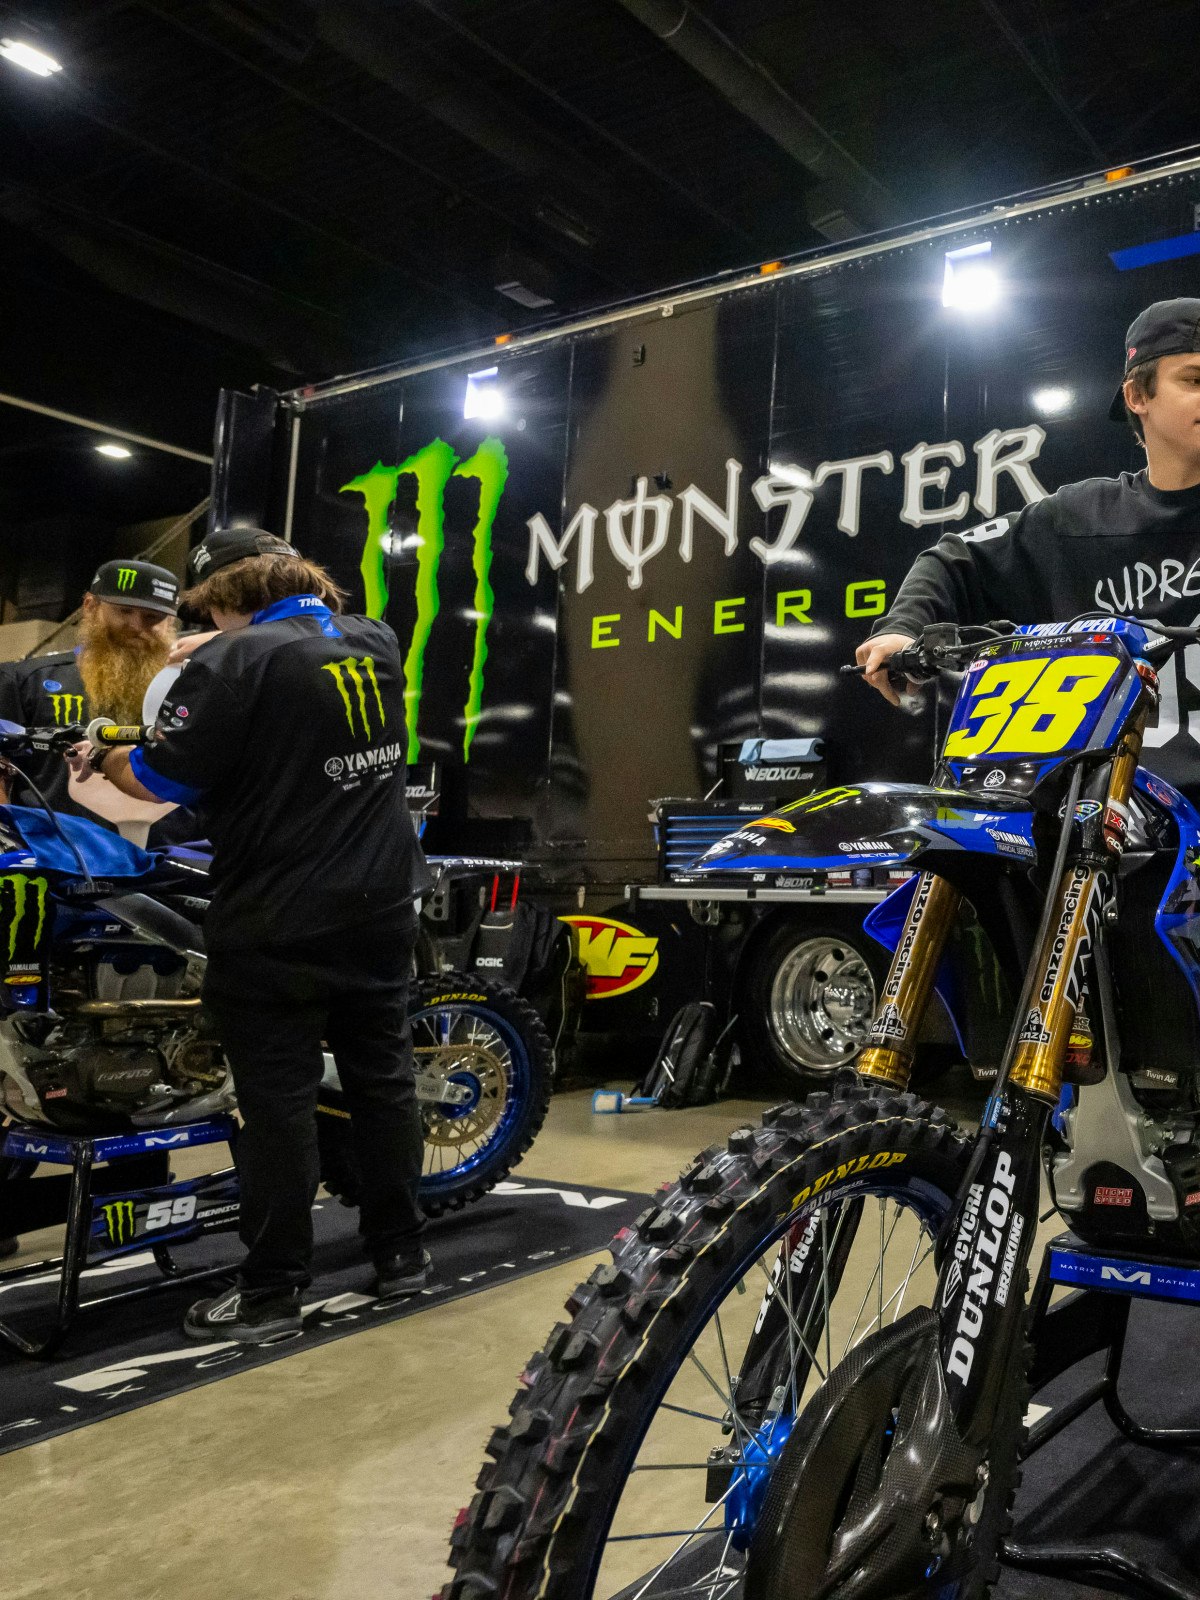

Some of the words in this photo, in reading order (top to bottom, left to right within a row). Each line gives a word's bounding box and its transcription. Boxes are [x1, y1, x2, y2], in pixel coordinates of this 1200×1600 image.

[525, 424, 1049, 593] MONSTER
[590, 580, 886, 650] ENERG
[1024, 636, 1073, 648] MONSTER
[943, 655, 1122, 758] 38
[344, 742, 401, 772] YAMAHA
[755, 766, 801, 781] BOXO
[850, 841, 894, 851] YAMAHA
[1000, 830, 1031, 847] YAMAHA
[462, 857, 523, 867] DUNLOP
[1040, 864, 1091, 1003] enzoracing
[578, 927, 659, 977] MF
[8, 962, 40, 971] YAMALUBE
[429, 992, 488, 1006] DUNLOP
[871, 1019, 907, 1040] enzo
[977, 1067, 998, 1077] Twin
[1146, 1069, 1163, 1081] Twin
[1163, 1074, 1176, 1084] Air
[789, 1151, 908, 1213] DUNLOP
[1095, 1187, 1133, 1197] LIGHT
[145, 1194, 197, 1230] 59
[1094, 1197, 1132, 1207] SPEED
[955, 1182, 985, 1262] CYCRA
[946, 1150, 1018, 1387] DUNLOP
[995, 1213, 1024, 1306] BRAKING
[1060, 1264, 1096, 1273] MATRIX
[1157, 1277, 1197, 1288] MATRIX
